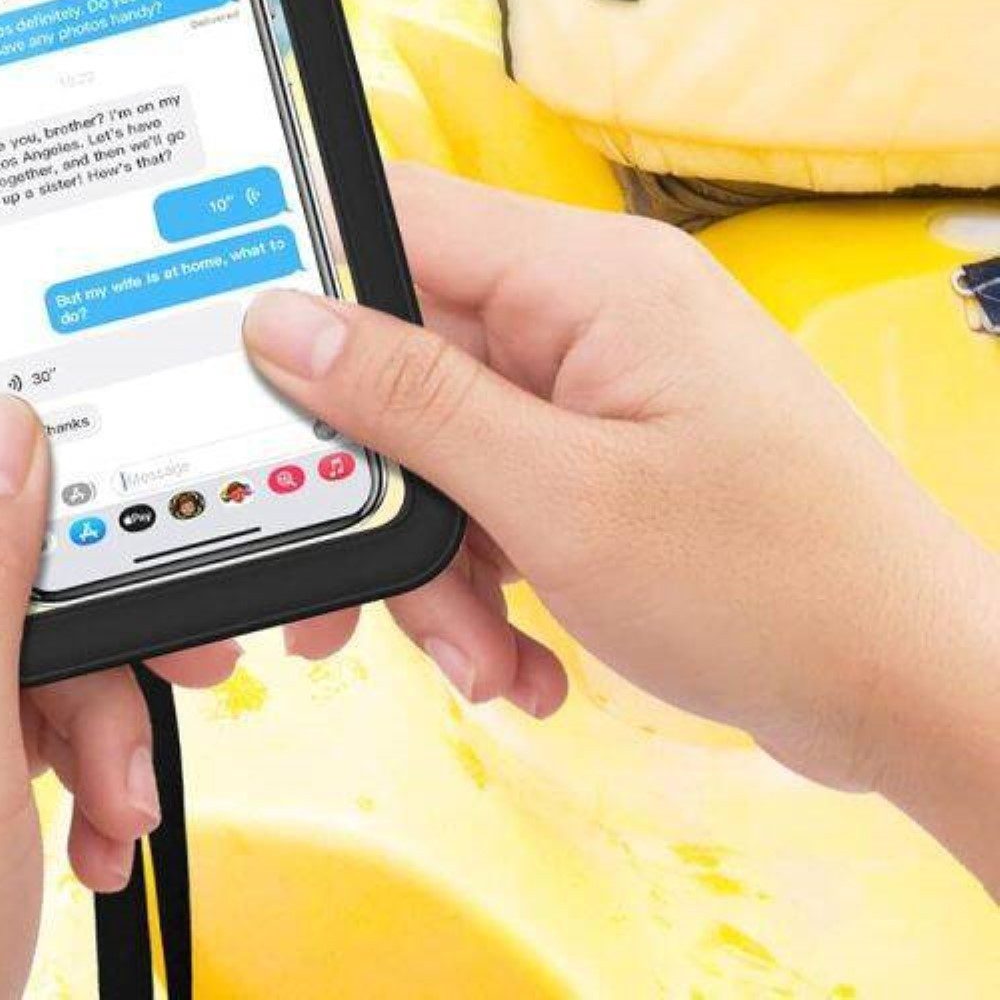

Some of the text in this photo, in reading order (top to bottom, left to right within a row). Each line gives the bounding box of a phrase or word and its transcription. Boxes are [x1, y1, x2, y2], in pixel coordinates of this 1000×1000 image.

[16, 6, 85, 31] definitely.
[87, 0, 107, 11] Do
[29, 32, 55, 48] any
[59, 20, 107, 42] photos
[111, 2, 163, 25] handy?
[10, 134, 41, 150] you,
[44, 113, 104, 139] brother?
[109, 108, 132, 121] I'm
[137, 102, 154, 114] on
[158, 94, 181, 109] my
[23, 140, 84, 165] Angeles.
[87, 129, 123, 147] Let's
[127, 118, 162, 136] have
[62, 155, 90, 171] and
[95, 145, 125, 163] then
[130, 136, 162, 154] we'll
[167, 129, 186, 144] go
[1, 193, 21, 206] up
[25, 189, 34, 199] a
[39, 176, 82, 196] sister!
[87, 164, 132, 183] How's
[137, 149, 172, 169] that?
[55, 238, 286, 306] But my wife is at home, what to
[61, 307, 87, 325] do?
